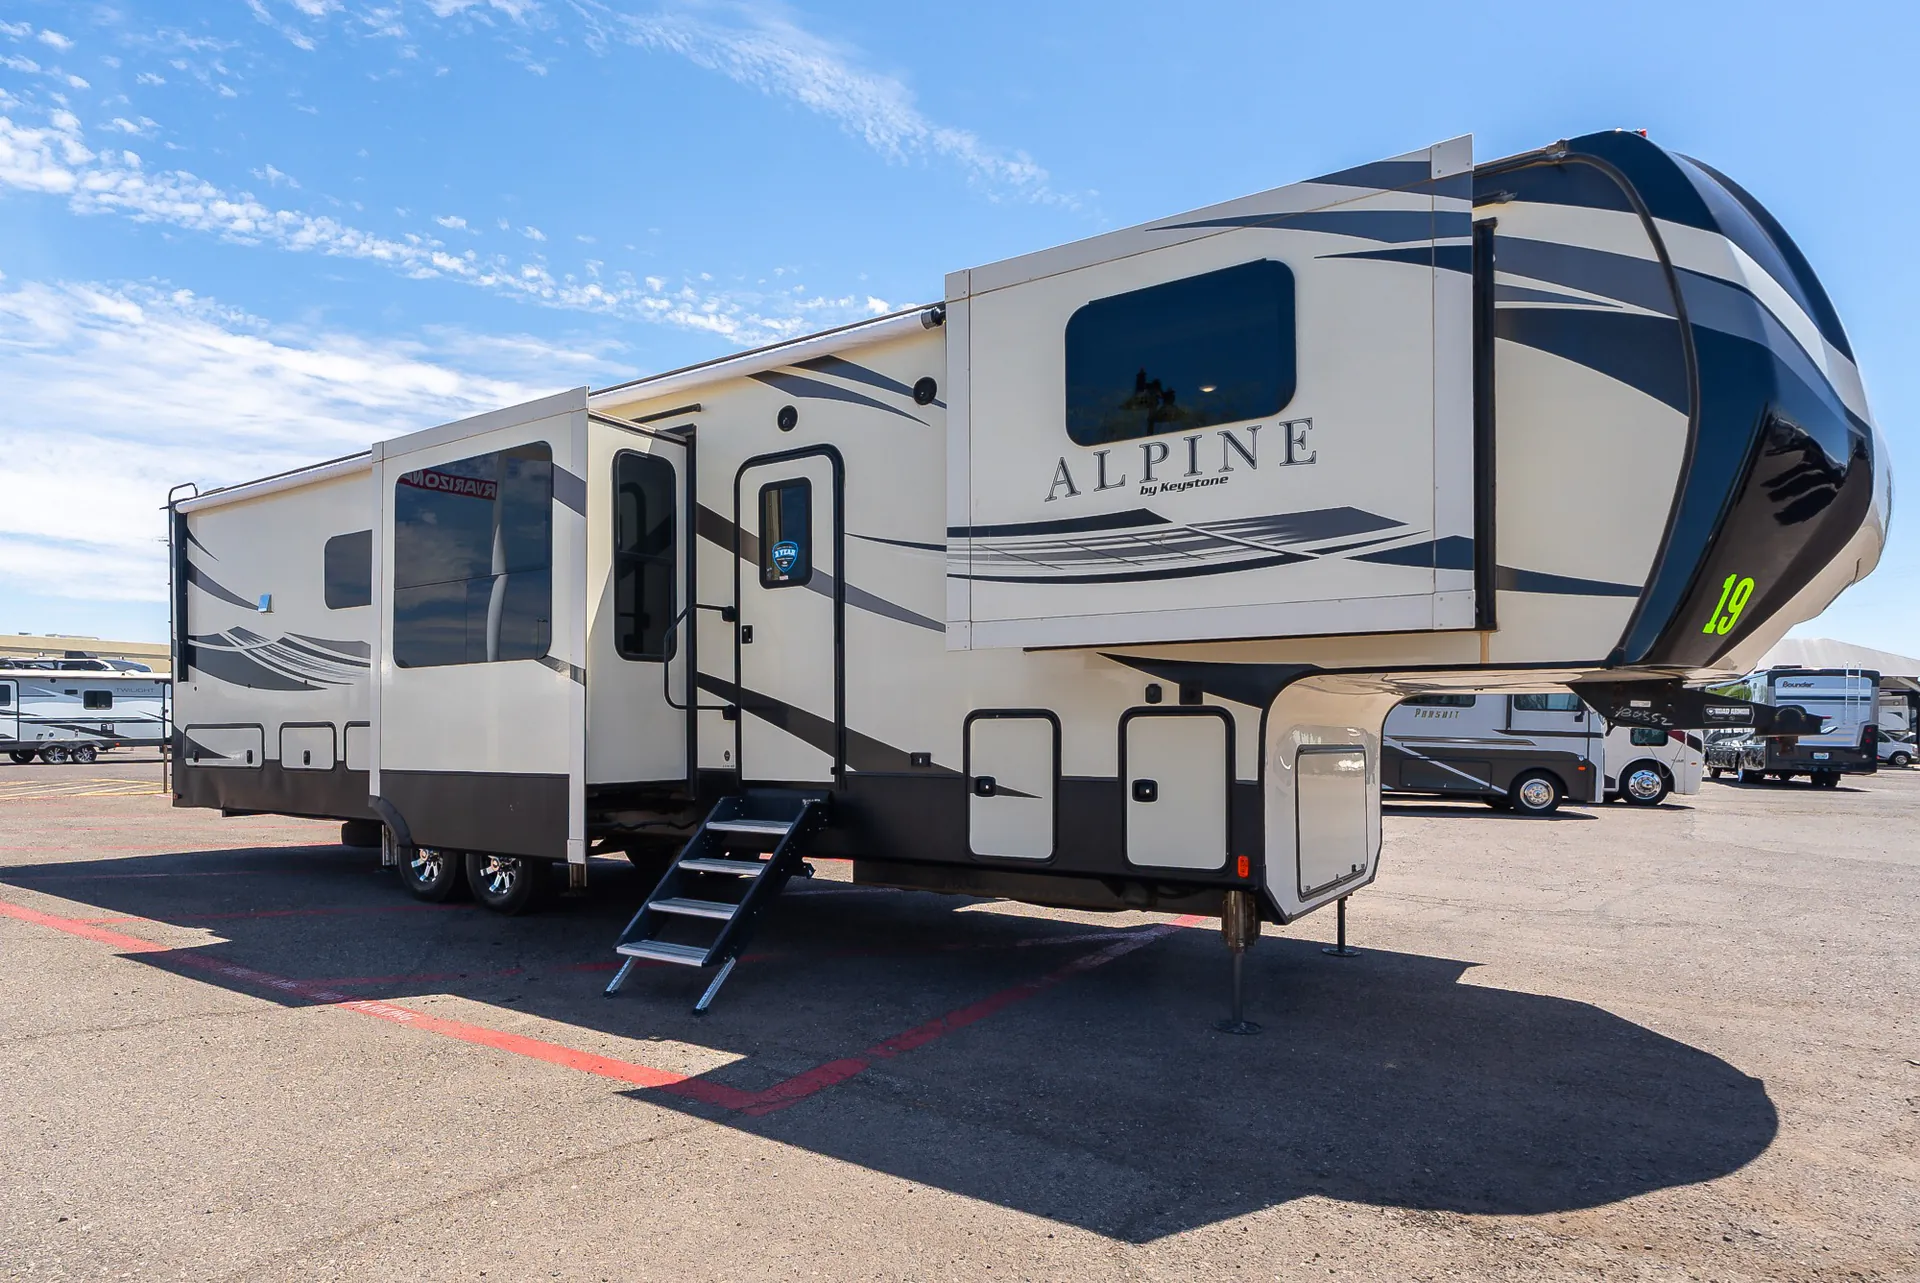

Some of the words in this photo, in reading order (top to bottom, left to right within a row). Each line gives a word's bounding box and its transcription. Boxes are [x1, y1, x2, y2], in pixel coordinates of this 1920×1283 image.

[1045, 417, 1317, 502] ALPINE
[1140, 484, 1158, 496] by
[1160, 475, 1229, 493] Keystone
[1702, 573, 1755, 635] 19
